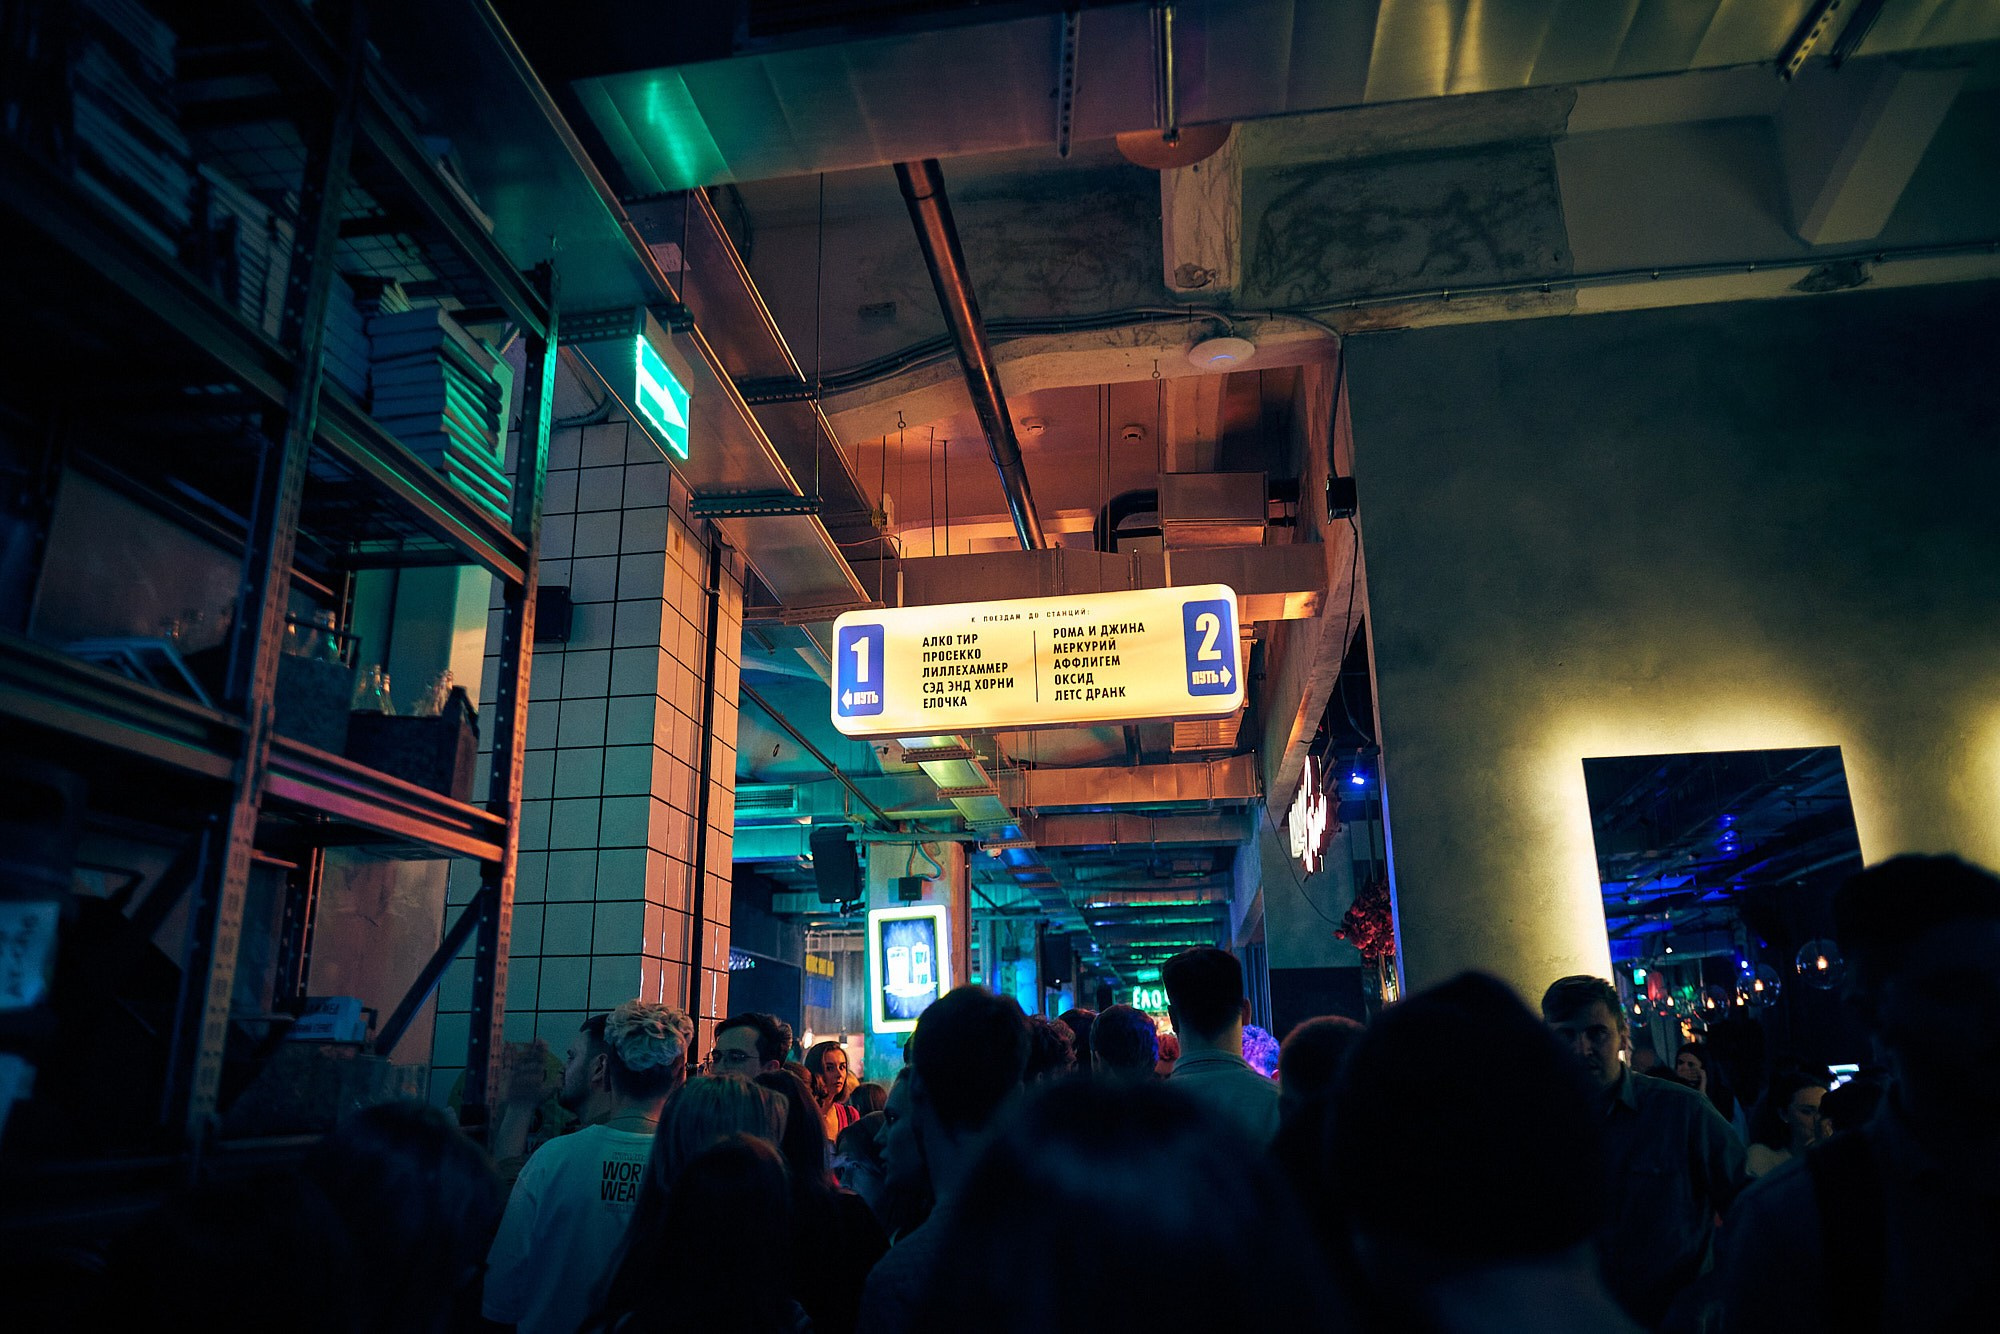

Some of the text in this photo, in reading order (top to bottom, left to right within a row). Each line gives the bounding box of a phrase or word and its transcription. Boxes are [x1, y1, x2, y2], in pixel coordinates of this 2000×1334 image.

[983, 613, 1021, 622] ПОЕЗДАМ
[1028, 612, 1039, 620] ДО
[1053, 622, 1145, 639] РОМА И ДЖИНА
[1195, 612, 1221, 661] 2
[922, 633, 978, 647] АЛКО ТИР
[1053, 637, 1117, 654] МЕРКУРИЙ
[850, 636, 869, 683] 1
[922, 648, 982, 662] ПРОСЕККО
[1053, 655, 1121, 670] АФФЛИГЕМ
[922, 662, 1009, 678] ЛИЛЛЕХАММЕР
[1191, 670, 1220, 685] ПУТЬ
[922, 677, 1014, 694] СЭД ЭНД ХОРНИ
[1054, 672, 1094, 686] ОКСИД
[853, 691, 879, 705] ПУТЬ
[1054, 686, 1126, 701] ЛЕТС ДРАНК
[923, 696, 968, 709] ЕЛОЧКА
[602, 1160, 646, 1182] WOR
[600, 1180, 637, 1202] WEA
